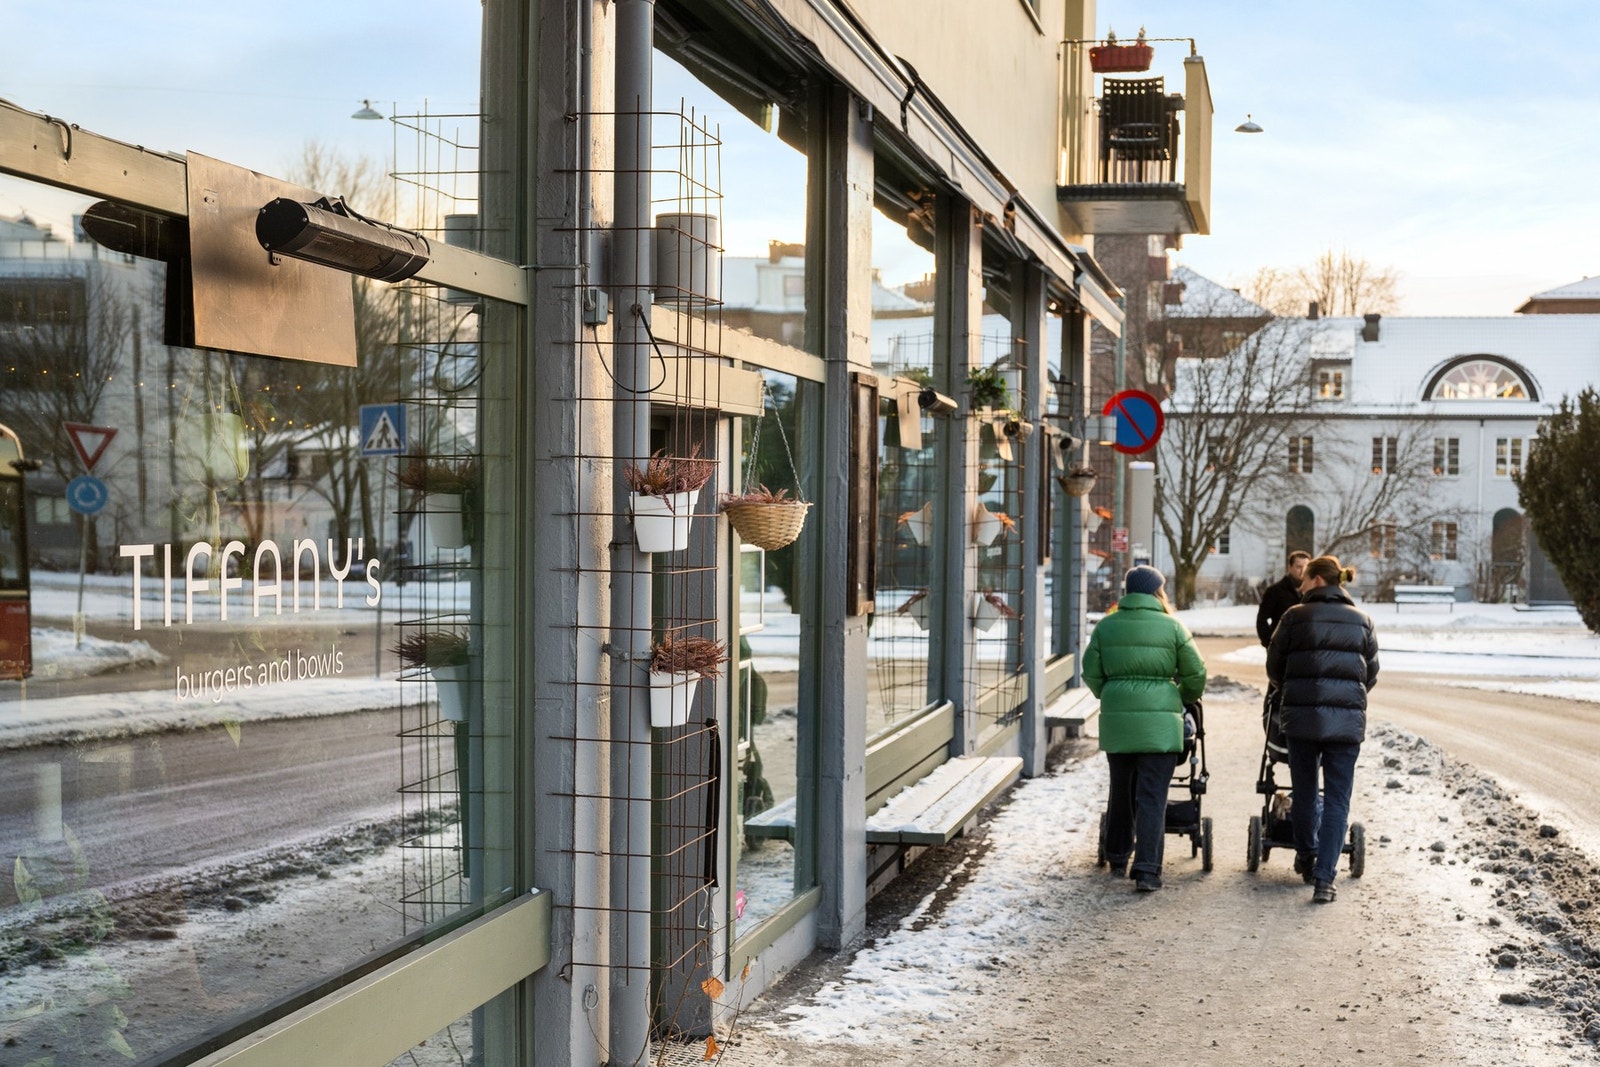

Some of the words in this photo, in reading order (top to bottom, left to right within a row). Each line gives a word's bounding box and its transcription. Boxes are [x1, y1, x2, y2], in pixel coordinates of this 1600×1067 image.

[176, 665, 253, 703] burgers
[257, 650, 292, 688] and
[296, 643, 344, 680] bowls
